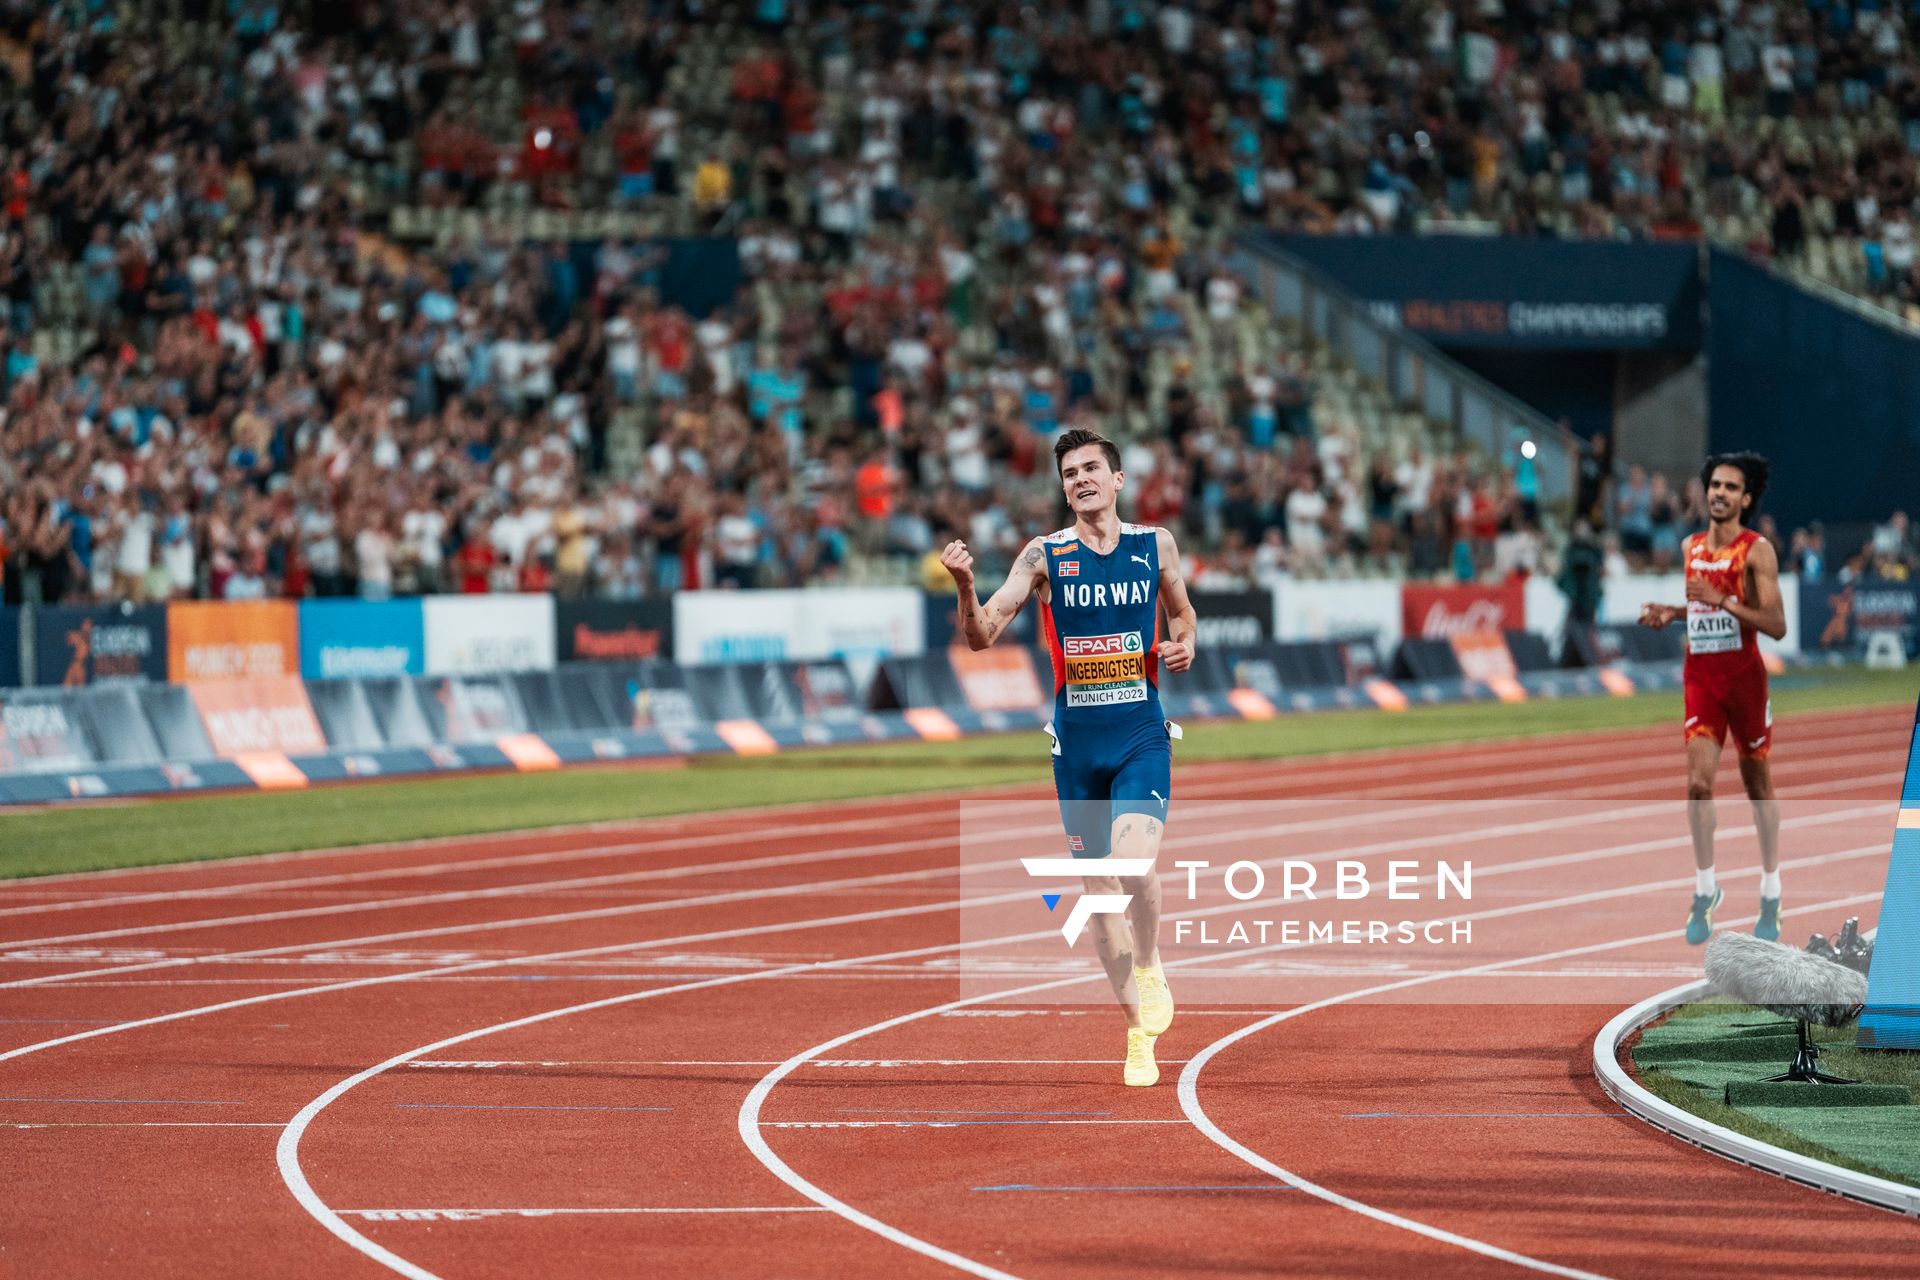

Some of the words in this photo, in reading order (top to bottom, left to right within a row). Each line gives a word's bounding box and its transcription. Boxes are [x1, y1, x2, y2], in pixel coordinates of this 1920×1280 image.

[1064, 580, 1151, 607] NORWAY
[1066, 637, 1122, 654] SPAR
[1066, 657, 1143, 680] INGEBRIGTSEN
[1071, 692, 1114, 703] MUNICH
[1117, 689, 1144, 700] 2022
